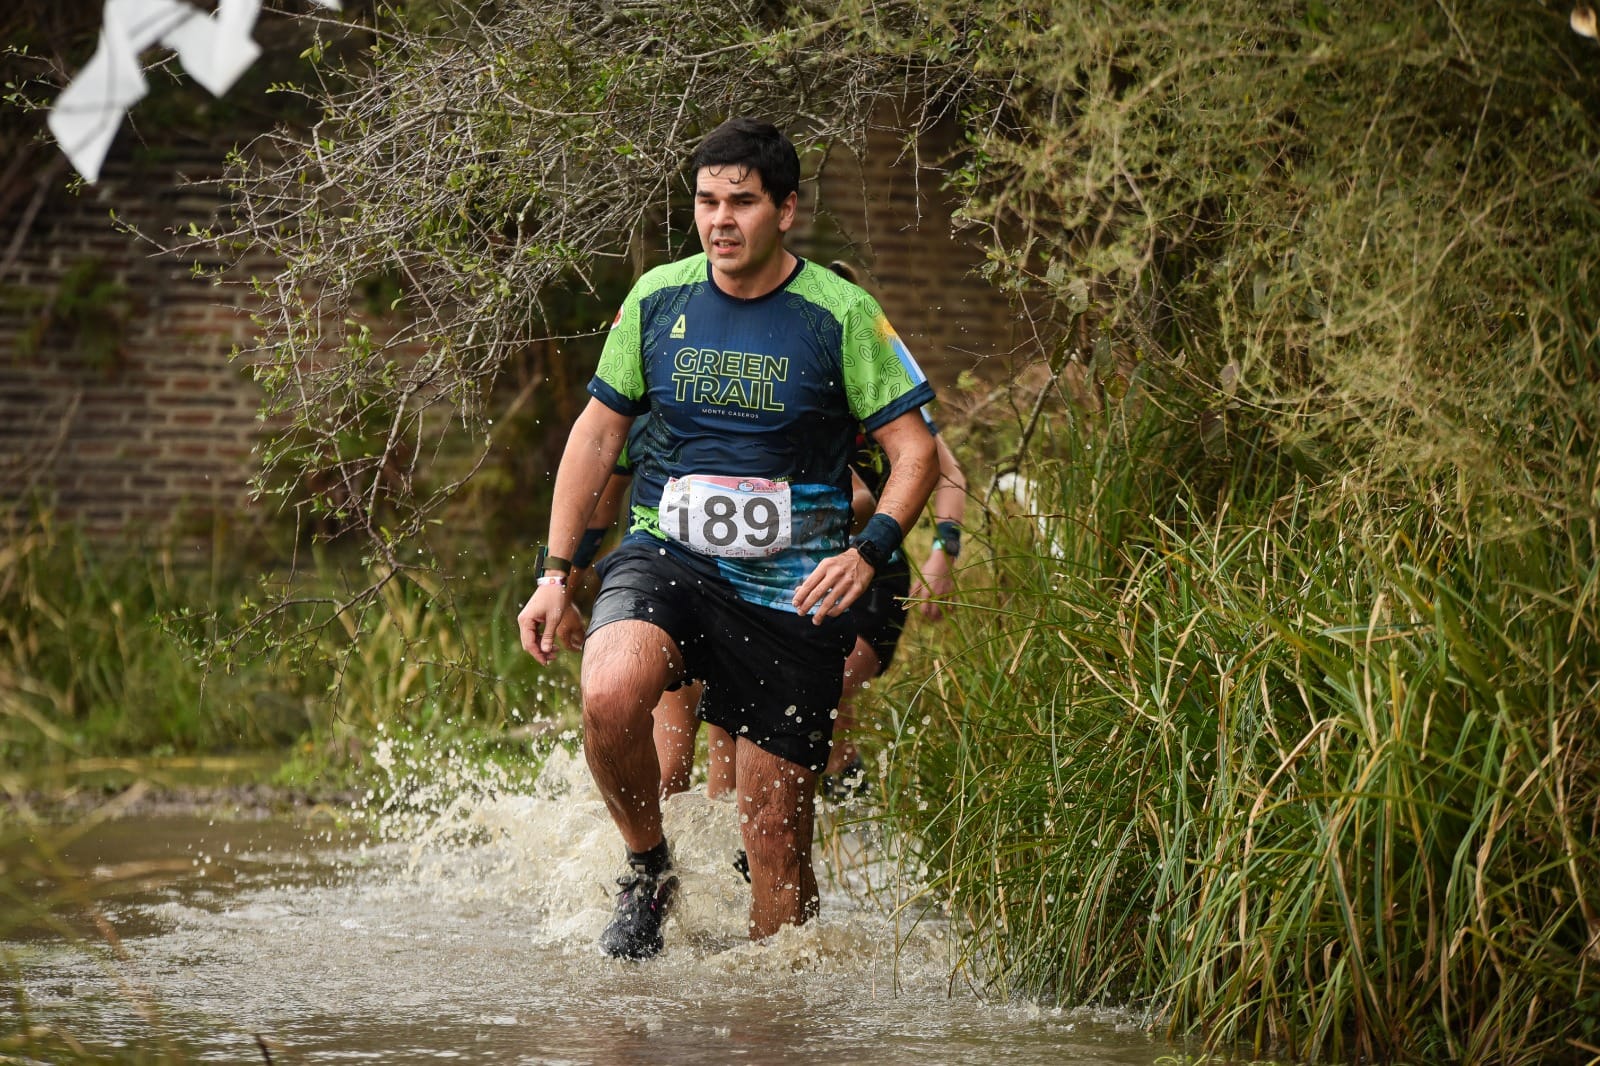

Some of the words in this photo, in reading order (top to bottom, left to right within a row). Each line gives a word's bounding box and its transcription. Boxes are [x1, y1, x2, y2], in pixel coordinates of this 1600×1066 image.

[674, 347, 789, 382] GREEN
[672, 372, 785, 412] TRAIL
[701, 408, 726, 416] MONTE
[728, 410, 759, 419] CASEROS
[667, 493, 780, 548] 189
